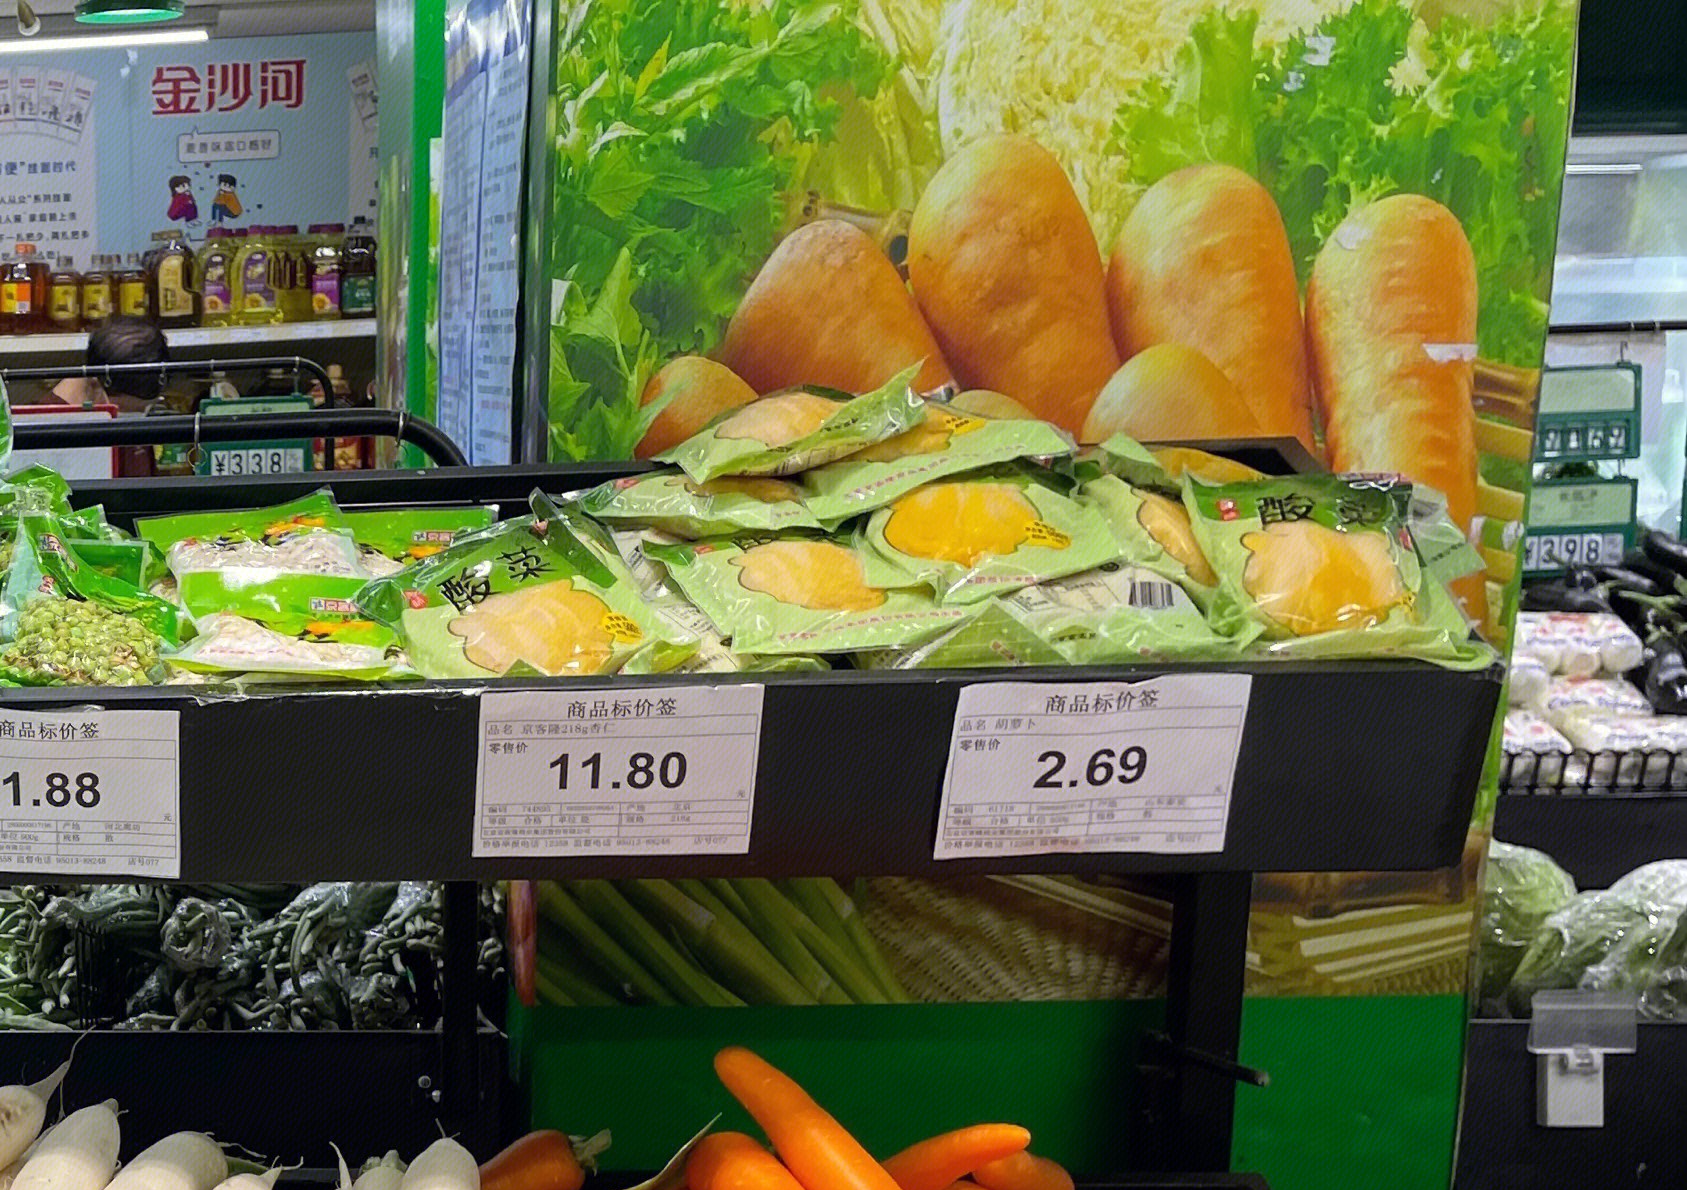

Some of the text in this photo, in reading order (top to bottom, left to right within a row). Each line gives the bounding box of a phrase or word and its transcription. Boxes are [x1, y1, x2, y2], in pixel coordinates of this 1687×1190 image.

[152, 59, 306, 116] 金沙河
[567, 698, 677, 719] 商品标价签
[1045, 690, 1160, 714] 商品标价签
[488, 723, 514, 735] 品名
[960, 717, 1037, 732] 品名 胡萝卜
[488, 742, 529, 755] 零售价
[960, 738, 1001, 752] 零售价
[549, 752, 687, 790] 11.80
[1033, 746, 1148, 789] 2.69
[2, 771, 101, 808] 1.88
